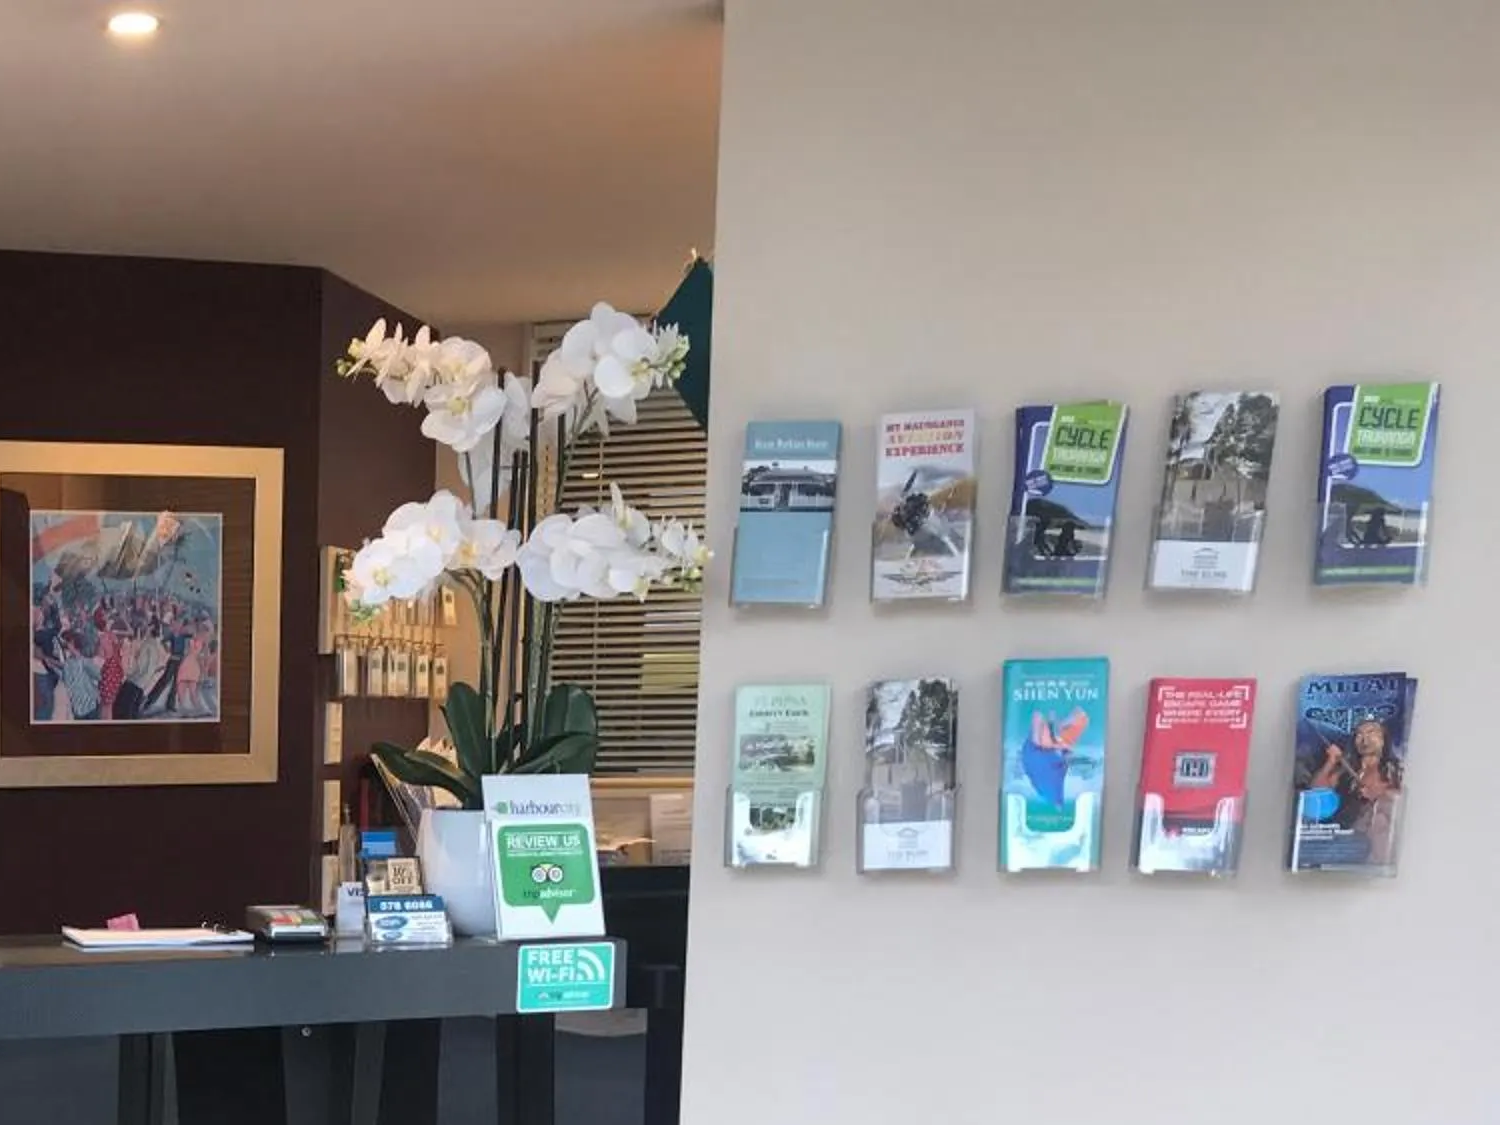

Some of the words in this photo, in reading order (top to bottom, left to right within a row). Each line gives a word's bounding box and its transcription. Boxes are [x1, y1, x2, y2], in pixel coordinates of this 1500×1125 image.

[1360, 407, 1420, 429] CYCLE
[1055, 425, 1111, 449] CYCLE
[1013, 687, 1059, 701] SHEN
[1063, 687, 1099, 701] YUN
[506, 833, 557, 849] REVIEW
[563, 833, 581, 847] US
[527, 948, 574, 965] FREE
[527, 966, 576, 983] WI-FI
